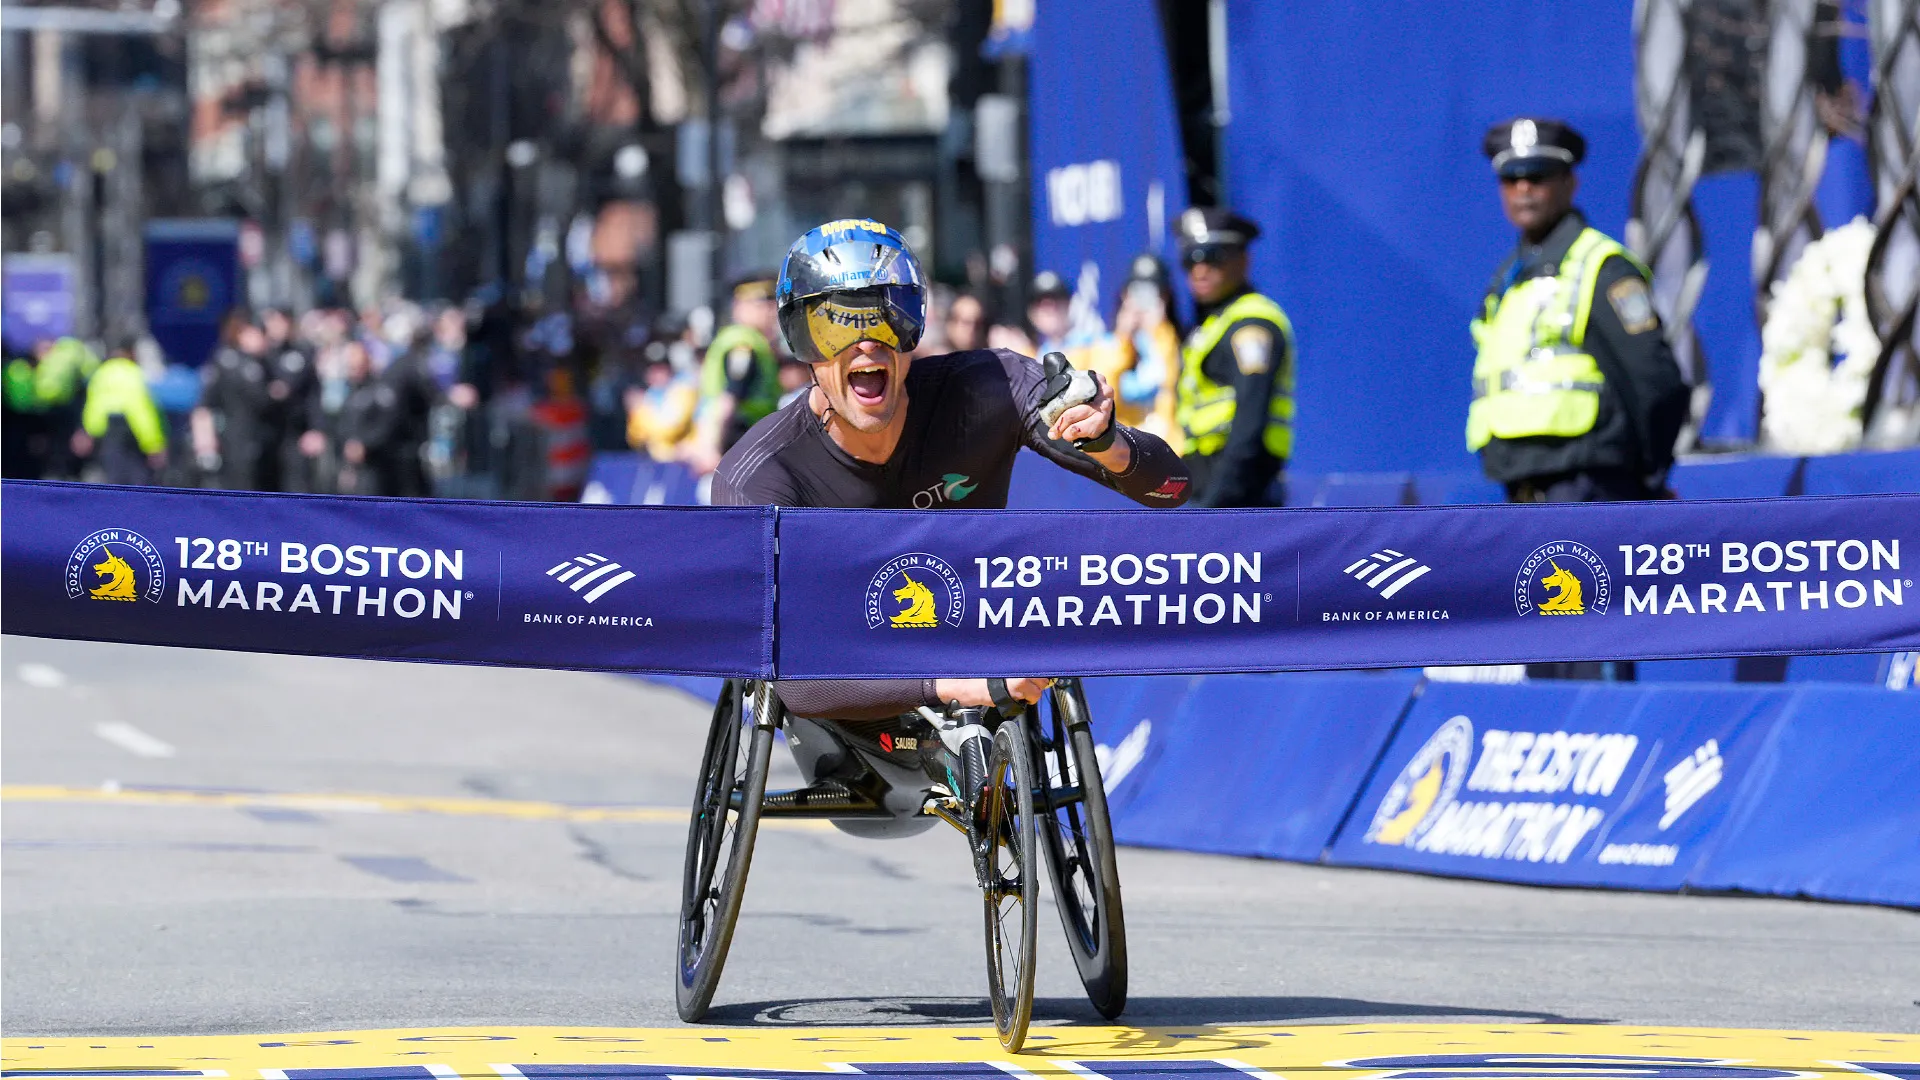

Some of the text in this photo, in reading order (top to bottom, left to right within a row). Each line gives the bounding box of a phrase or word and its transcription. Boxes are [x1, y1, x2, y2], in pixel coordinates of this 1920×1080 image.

[820, 219, 888, 238] Marcel
[829, 269, 874, 286] Allianz
[69, 531, 162, 597] 2024 BOSTON MARATHON
[174, 536, 464, 581] 128TH BOSTON
[974, 551, 1262, 589] 128TH BOSTON
[1618, 539, 1900, 576] 128TH BOSTON
[868, 556, 962, 623] 2024 BOSTON MARATHON
[1517, 544, 1608, 610] 2024 BOSTON MARATHON
[523, 613, 654, 627] BANK OF AMERICA
[1322, 609, 1450, 622] BANK OF AMERICA
[894, 737, 918, 750] SAUBER
